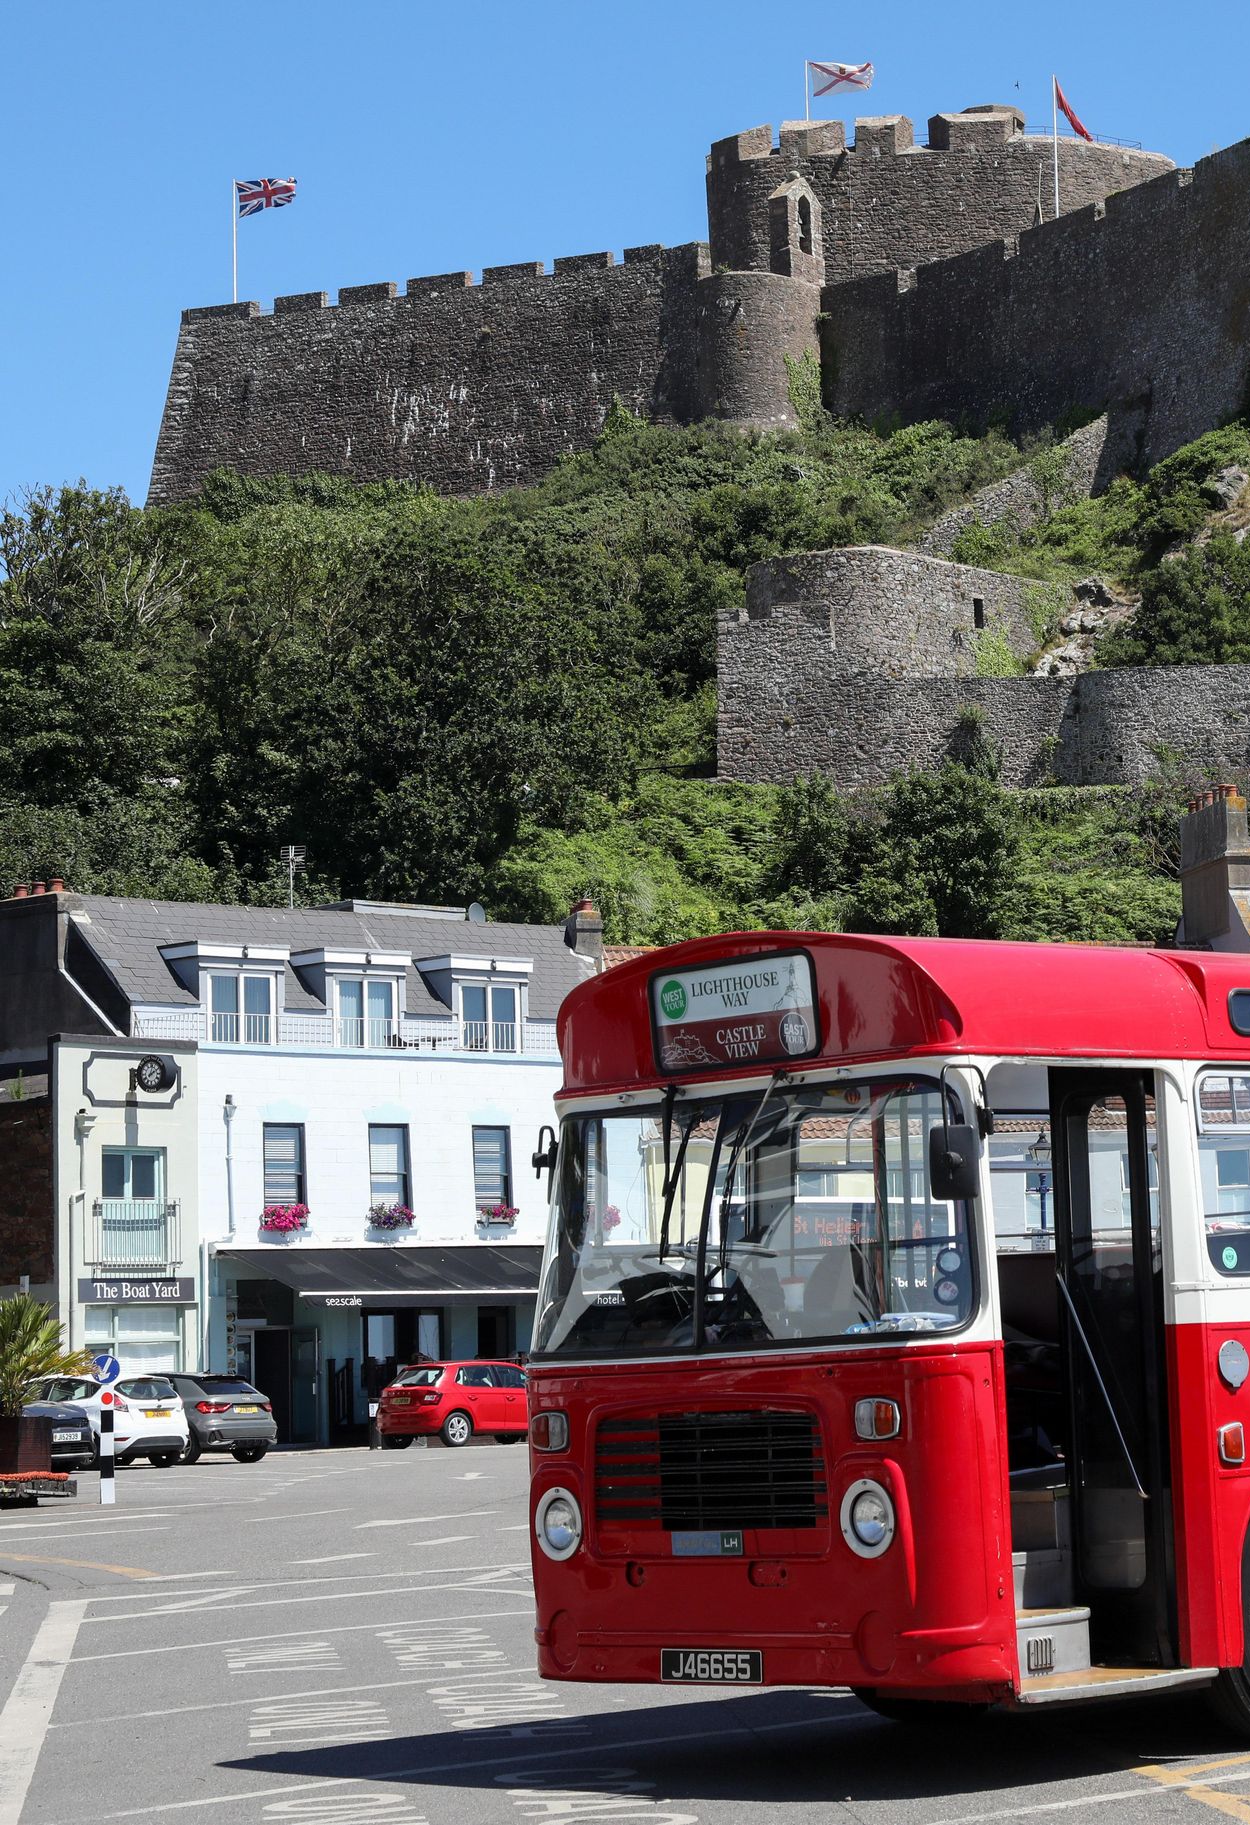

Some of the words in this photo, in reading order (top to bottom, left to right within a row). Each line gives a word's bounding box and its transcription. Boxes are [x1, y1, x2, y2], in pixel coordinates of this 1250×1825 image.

[691, 971, 780, 998] LIGHTHOUSE
[662, 988, 684, 1002] WEST
[721, 991, 750, 1009] WAY
[664, 1000, 686, 1012] TOUR
[716, 1024, 767, 1045] CASTLE
[783, 1023, 805, 1036] EAST
[785, 1033, 805, 1046] TOUR
[725, 1040, 761, 1060] VIEW
[794, 1216, 809, 1235] St
[814, 1216, 864, 1235] Helier
[93, 1282, 119, 1299] The
[121, 1282, 150, 1298] Boat
[151, 1281, 181, 1298] Yard
[597, 1294, 620, 1305] hotel
[723, 1538, 738, 1548] LH
[671, 1652, 751, 1680] J46655
